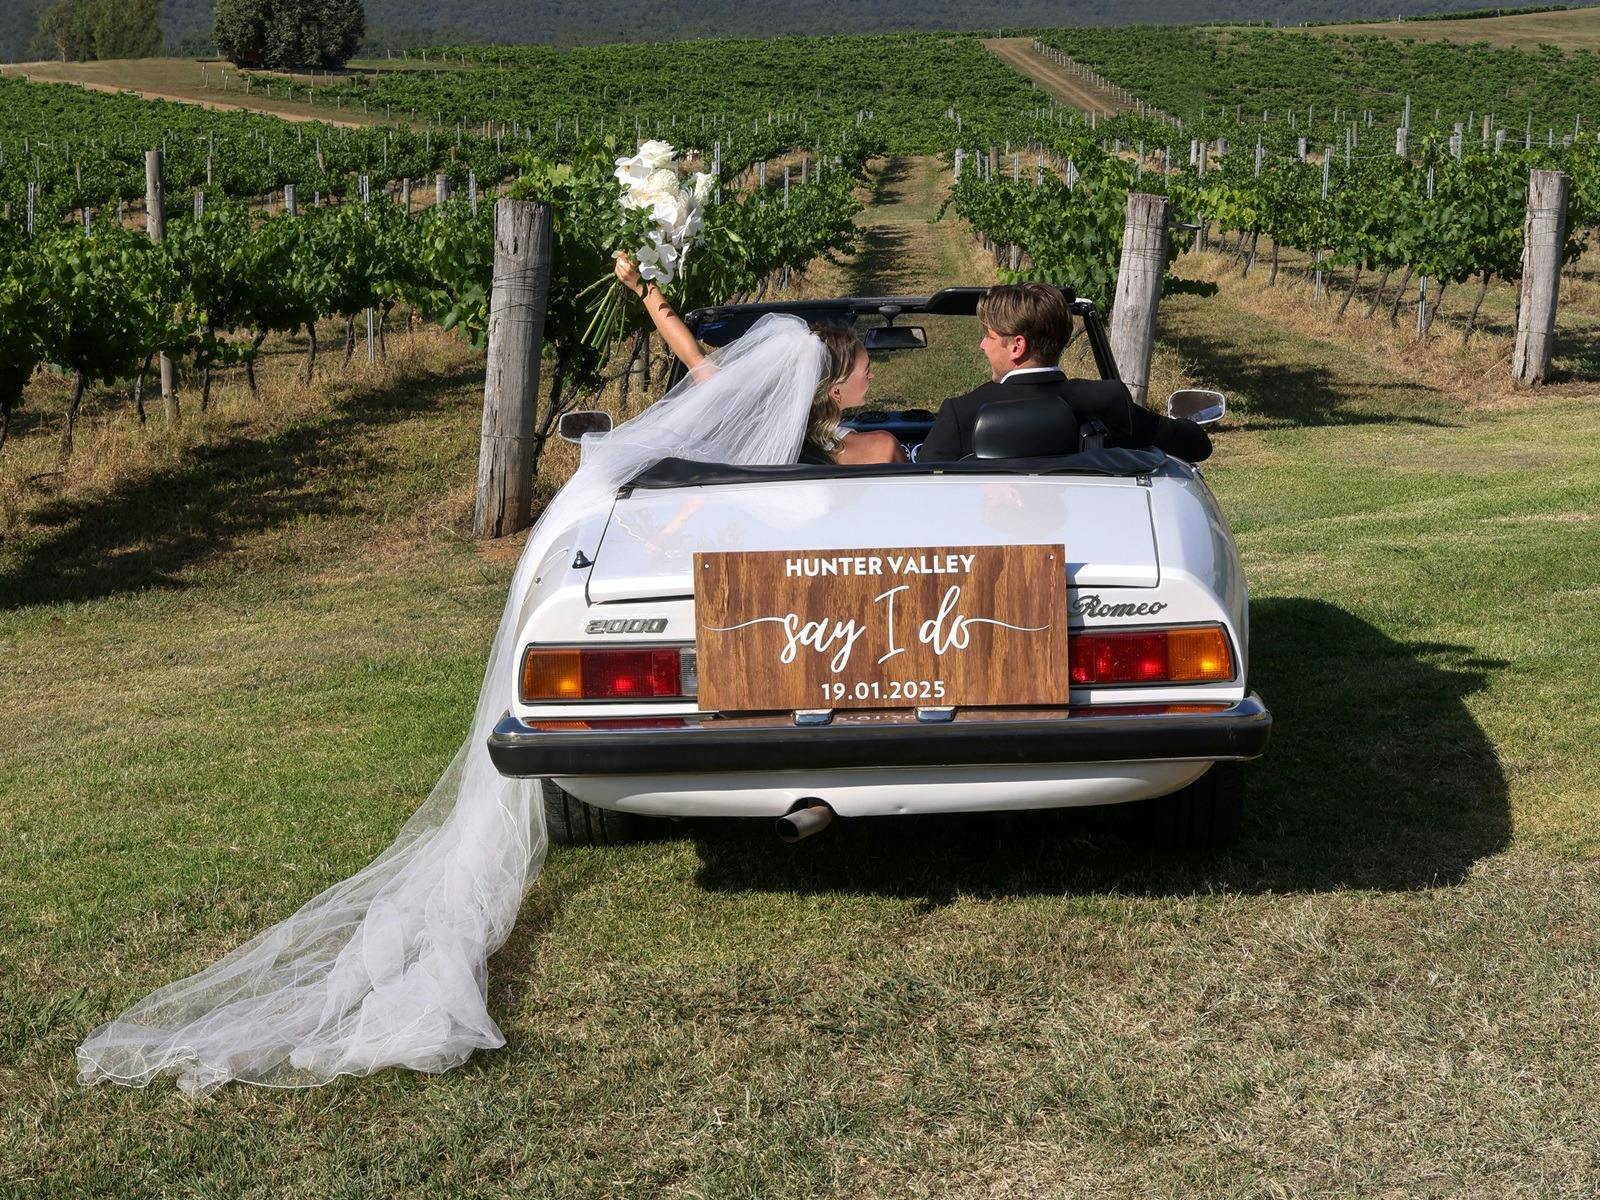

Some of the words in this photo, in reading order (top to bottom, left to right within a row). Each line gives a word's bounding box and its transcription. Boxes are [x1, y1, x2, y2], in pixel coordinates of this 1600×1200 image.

[786, 556, 884, 577] HUNTER
[887, 555, 976, 575] VALLEY
[1069, 594, 1168, 619] Romeo
[584, 617, 669, 635] 2000
[780, 612, 867, 673] say
[874, 585, 910, 665] I
[821, 680, 946, 701] 19.01.2025
